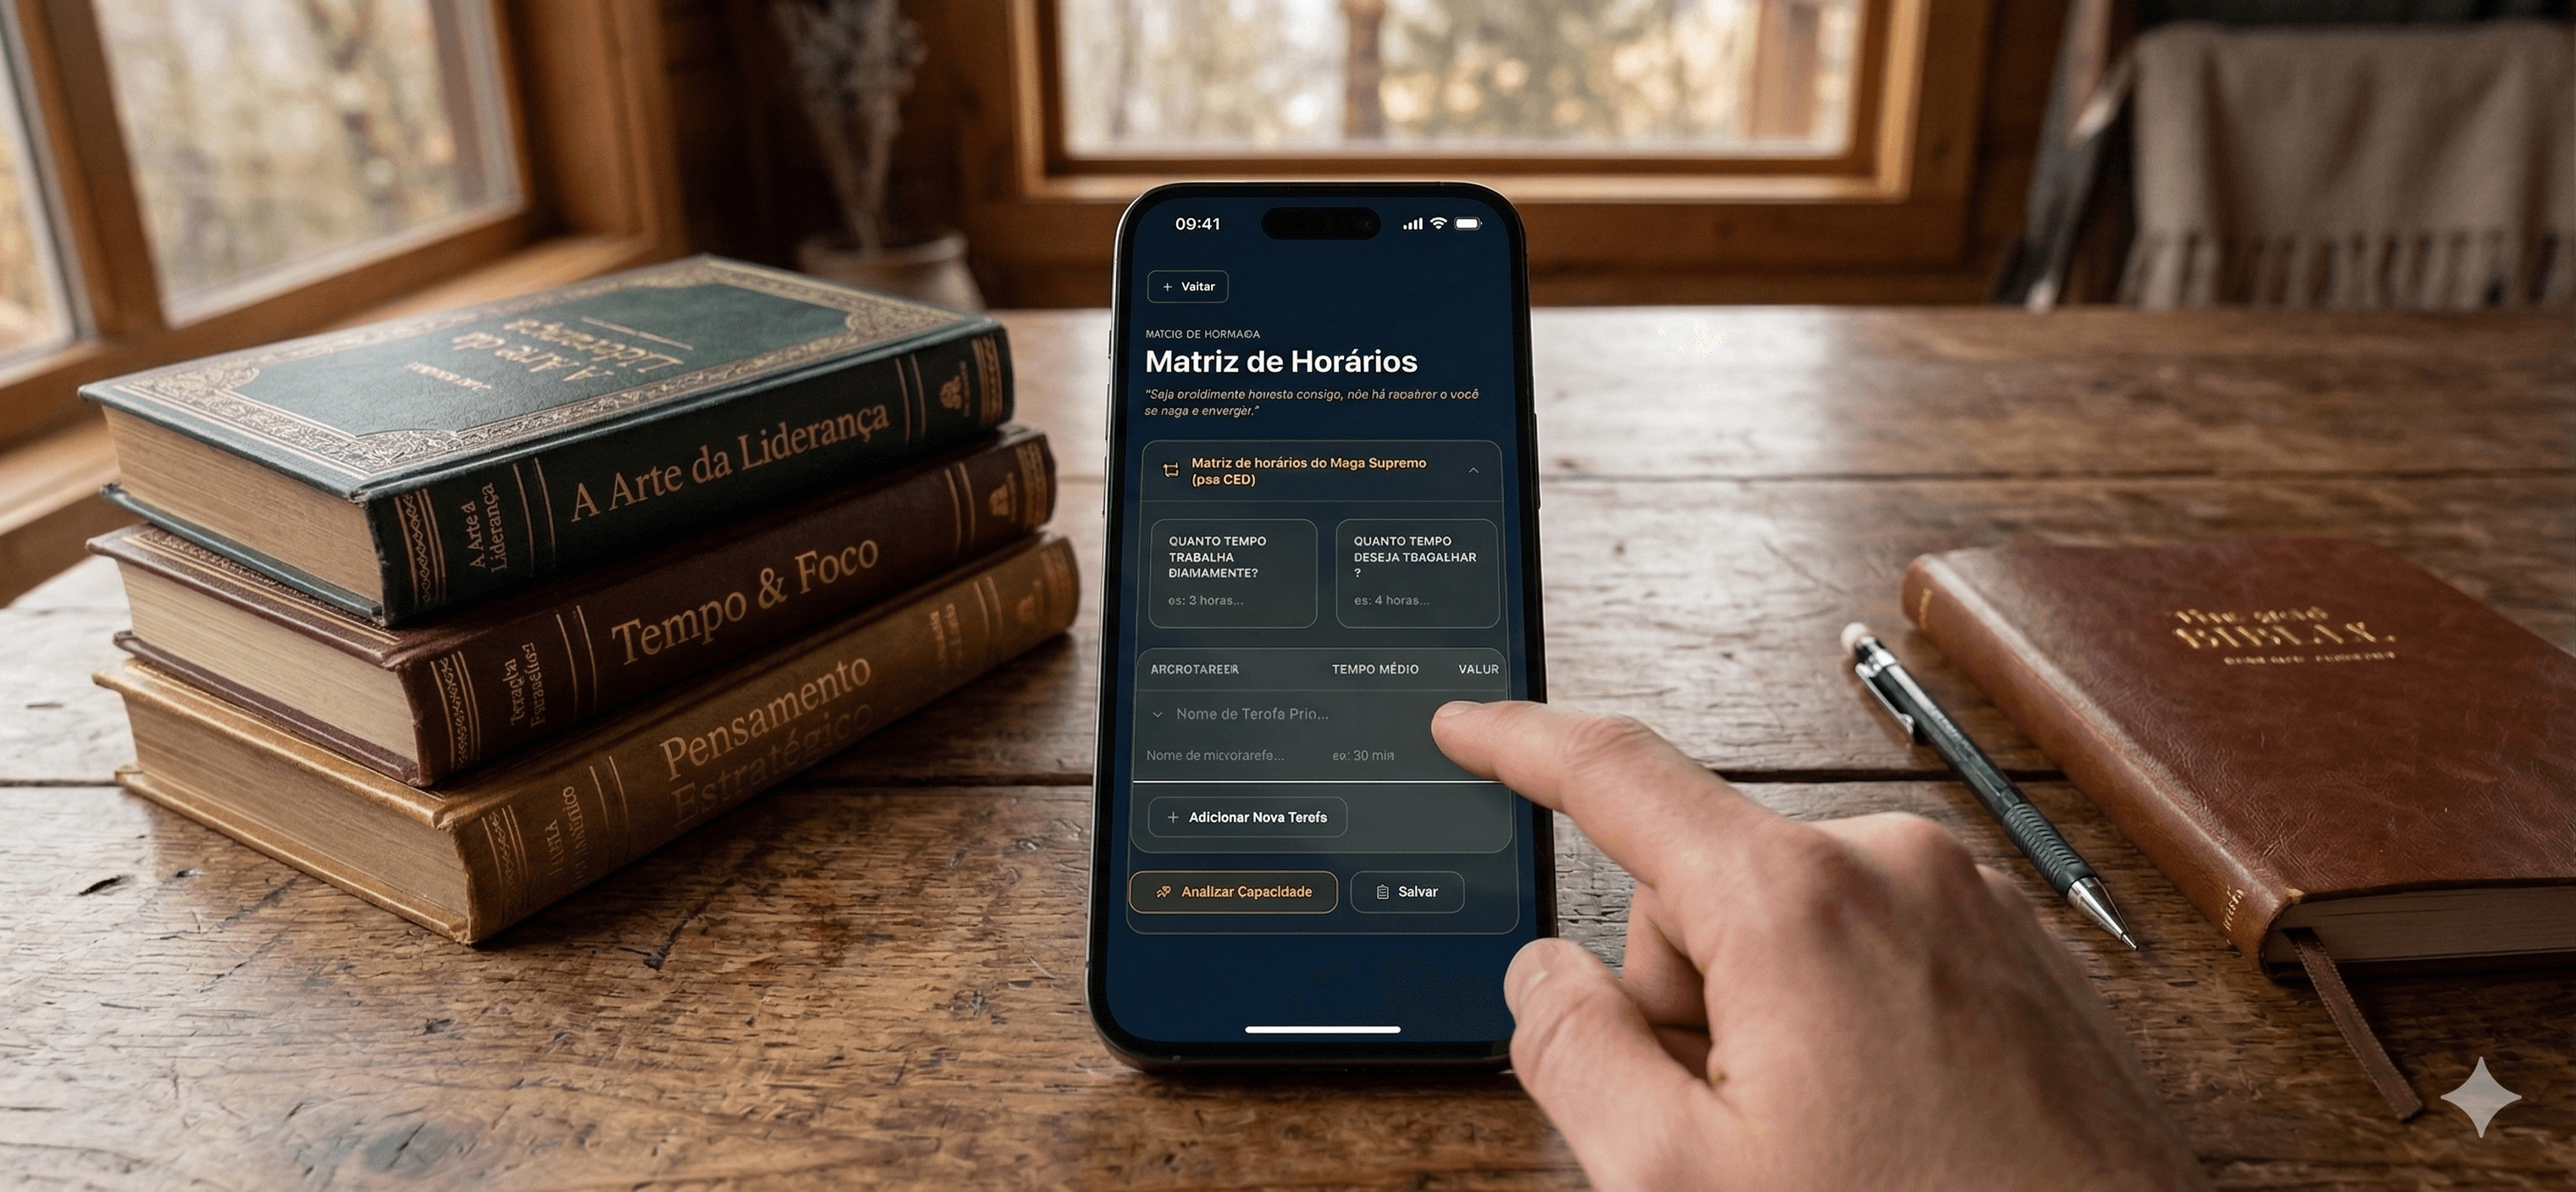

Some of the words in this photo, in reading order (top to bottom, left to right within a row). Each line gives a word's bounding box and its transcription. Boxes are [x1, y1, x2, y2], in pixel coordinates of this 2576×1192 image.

[1175, 217, 1219, 231] 09:41
[1181, 281, 1216, 292] Vaitar
[1186, 329, 1202, 339] DE
[1146, 349, 1239, 373] Matriz
[1247, 350, 1284, 373] de
[1292, 348, 1418, 373] Horários
[1296, 389, 1344, 402] consigo,
[1371, 388, 1385, 400] há
[1450, 388, 1479, 400] você
[1144, 407, 1158, 416] se
[1161, 407, 1189, 419] naga
[1191, 407, 1199, 416] e
[572, 483, 600, 522] A
[609, 465, 683, 511] Arte
[692, 444, 733, 484] da
[738, 403, 890, 471] Liderança
[1191, 456, 1233, 468] Matriz
[1235, 457, 1252, 469] de
[1254, 456, 1307, 468] horários
[1310, 457, 1328, 469] do
[1330, 457, 1366, 471] Maga
[1368, 457, 1427, 471] Supremo
[1223, 473, 1256, 488] CED)
[482, 483, 508, 572] Liderança
[466, 514, 482, 555] Arte
[1169, 536, 1221, 547] QUANTO
[1223, 536, 1267, 547] TEMPO
[1353, 536, 1407, 547] QUANTO
[1409, 536, 1452, 547] TEMPO
[470, 552, 485, 569] A
[1169, 552, 1235, 563] TRABALHA
[1354, 552, 1401, 563] DESEJA
[611, 591, 748, 665] Tempo
[759, 566, 787, 610] &
[794, 539, 880, 596] Foco
[1189, 594, 1197, 606] 3
[1200, 594, 1244, 606] horas...
[1374, 594, 1383, 605] 4
[1386, 594, 1430, 606] horas...
[1331, 664, 1376, 675] TEMPO
[1379, 661, 1419, 675] MÉDIO
[1458, 664, 1500, 675] VALUR
[660, 657, 872, 781] Pensamento
[1177, 708, 1218, 720] Nome
[1221, 707, 1238, 720] de
[1147, 749, 1183, 761] Nome
[1186, 749, 1201, 761] de
[1353, 749, 1369, 762] 30
[672, 705, 874, 828] Estratégico
[1188, 811, 1250, 824] Adicionar
[1252, 811, 1285, 823] Nova
[1287, 810, 1328, 824] Terefs
[1398, 885, 1439, 897] Salvar
